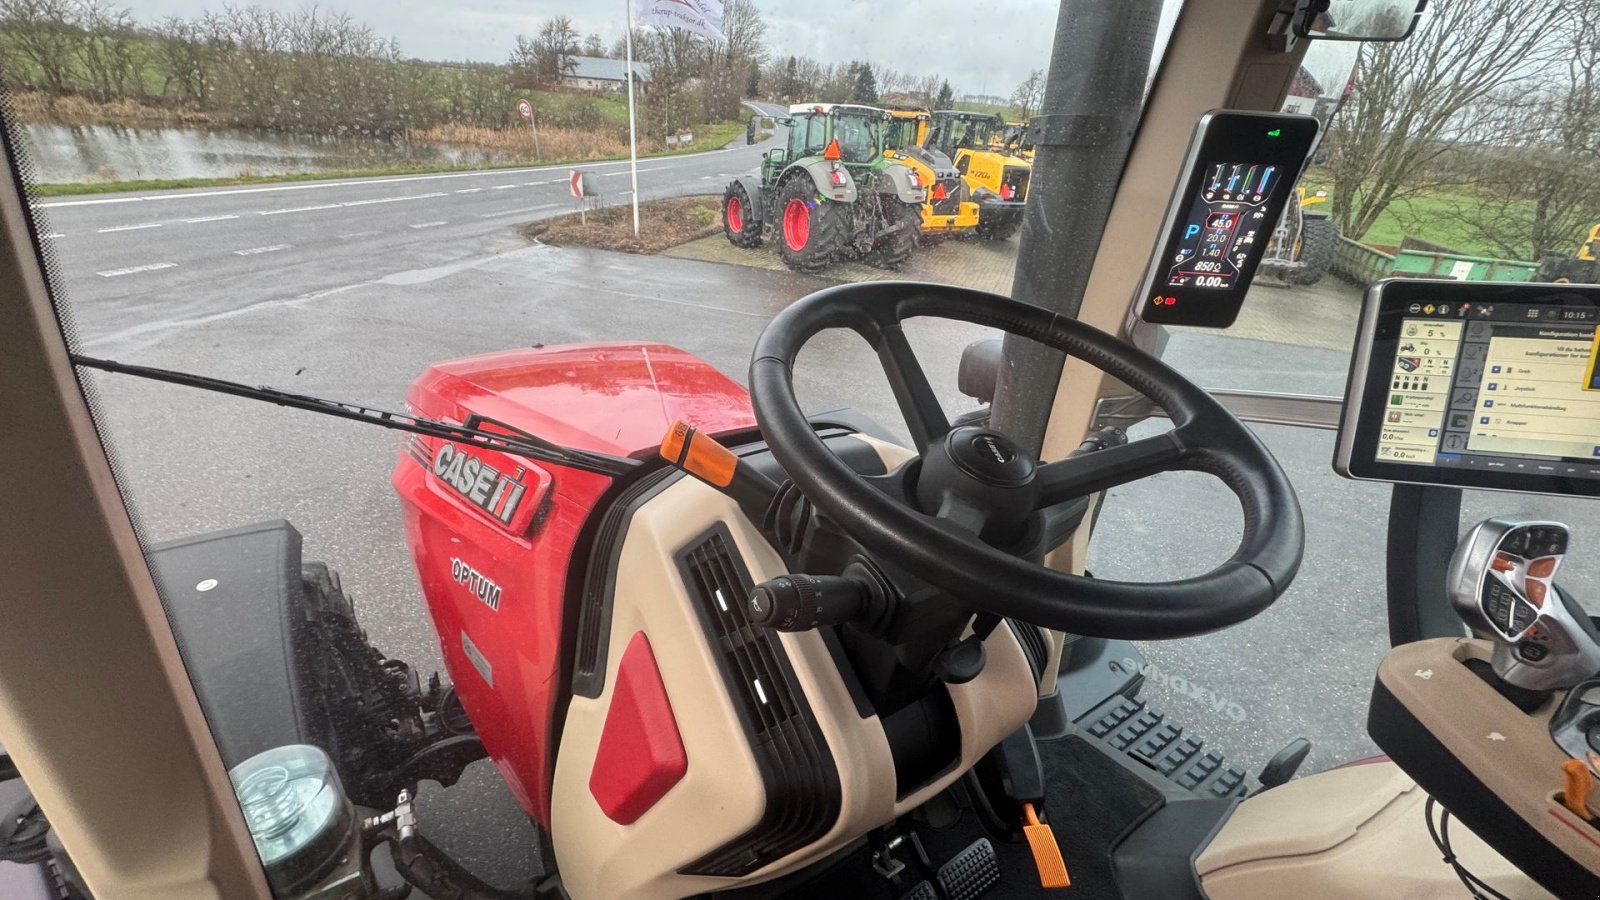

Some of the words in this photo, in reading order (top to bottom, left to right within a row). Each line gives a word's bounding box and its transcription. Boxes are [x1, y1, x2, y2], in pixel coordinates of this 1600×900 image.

[1212, 219, 1232, 228] 45.0
[1185, 225, 1199, 239] P
[1206, 233, 1227, 243] 20.0
[1201, 248, 1221, 257] 1.40
[1194, 261, 1215, 271] 850
[1195, 276, 1222, 287] 0.00
[1563, 311, 1586, 319] 10:15
[1426, 329, 1434, 337] 5
[1423, 347, 1431, 356] 0
[434, 442, 500, 506] CASE
[451, 557, 502, 612] OPTUM
